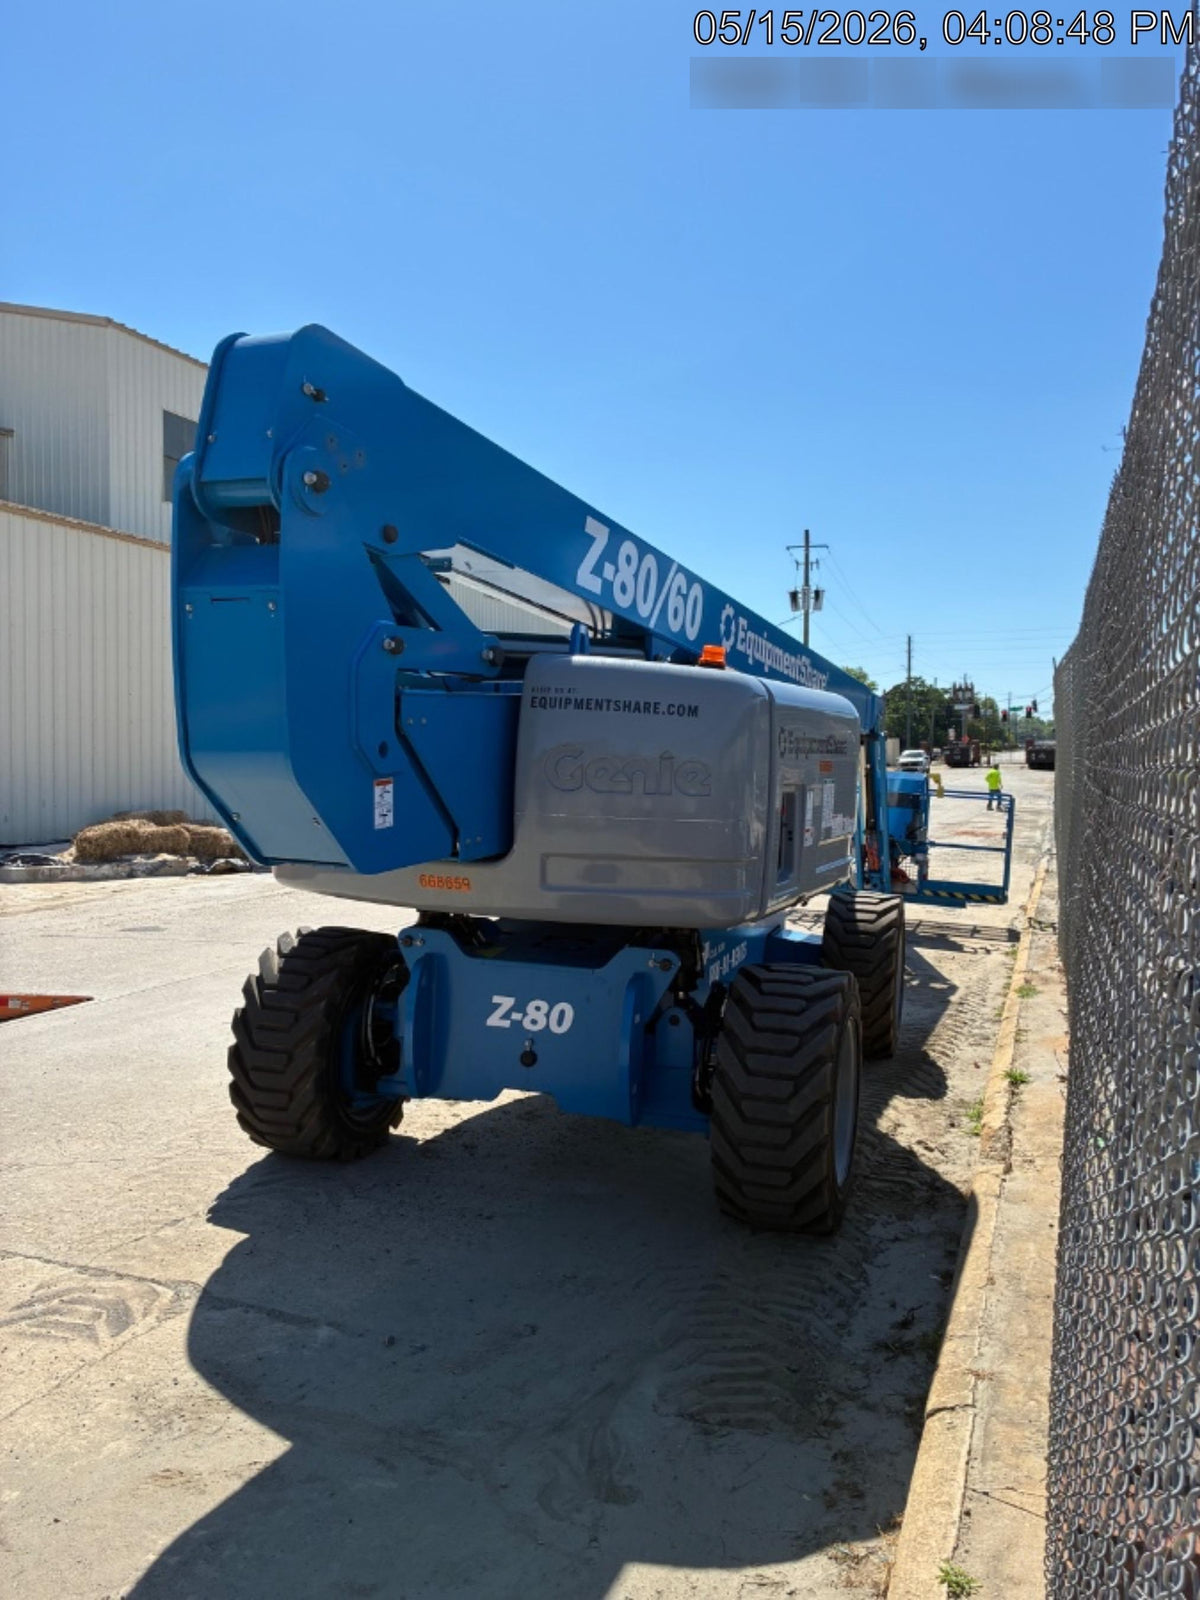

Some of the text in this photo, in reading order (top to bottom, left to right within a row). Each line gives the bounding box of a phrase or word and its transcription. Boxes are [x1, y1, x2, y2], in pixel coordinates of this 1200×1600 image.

[576, 515, 703, 641] Z-80/60
[530, 696, 700, 718] EQUIPMENTSHARE.COM
[544, 743, 712, 797] Genie
[486, 995, 575, 1034] Z-80
